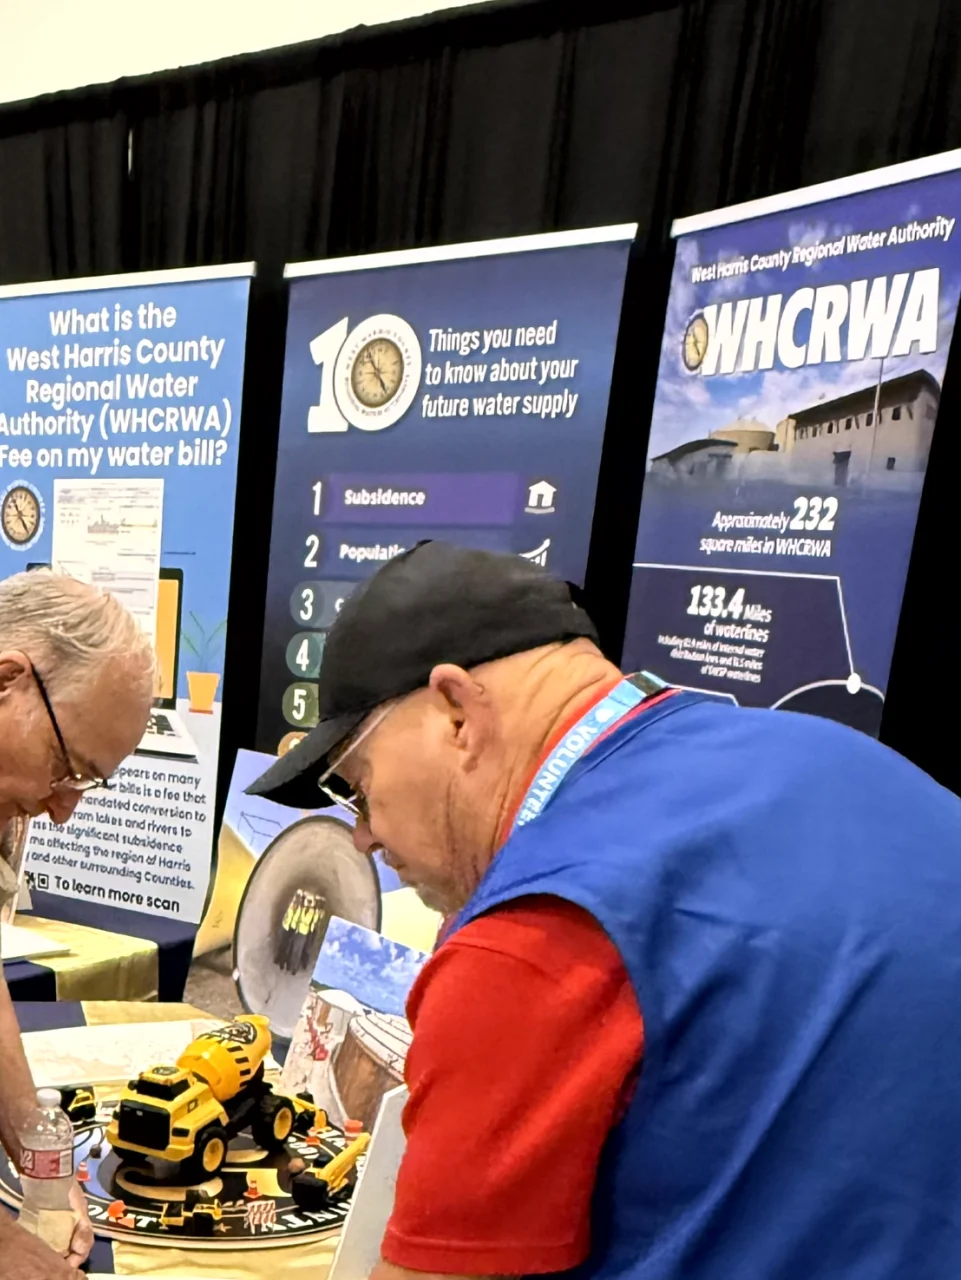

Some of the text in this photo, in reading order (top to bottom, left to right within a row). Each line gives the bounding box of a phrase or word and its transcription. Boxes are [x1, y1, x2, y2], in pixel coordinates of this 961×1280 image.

[691, 215, 956, 284] West Harris County Regional Water Authority
[49, 302, 176, 336] What is the
[699, 267, 940, 376] WHCRWA
[7, 335, 225, 371] West Harris County
[429, 319, 558, 356] Things you need
[425, 356, 579, 385] to know about your
[26, 372, 199, 410] Regional Water
[421, 388, 579, 419] future water supply
[99, 398, 232, 440] (WHCRWA)
[37, 448, 63, 467] on
[67, 447, 103, 475] my
[107, 442, 174, 467] water
[177, 439, 228, 466] bill?
[312, 481, 426, 516] 1 Subsidence
[711, 496, 839, 534] Approximately 232
[304, 534, 405, 567] 2 Populati
[699, 536, 832, 557] square miles in WHCRWA
[299, 588, 314, 621] 3
[686, 584, 773, 623] 133.4 Miles
[704, 619, 717, 636] of
[716, 623, 770, 643] waterlines
[295, 639, 310, 672] 4
[292, 689, 307, 720] 5
[168, 773, 200, 790] many
[183, 791, 206, 804] that
[125, 819, 145, 830] and
[148, 820, 178, 836] rivers
[194, 810, 206, 822] to
[122, 835, 183, 853] subsidence
[32, 852, 50, 862] and
[52, 854, 78, 867] other
[80, 860, 142, 883] surrounding
[111, 850, 143, 865] region
[145, 855, 157, 866] of
[158, 856, 191, 872] Harris
[54, 875, 180, 913] To learn more scan
